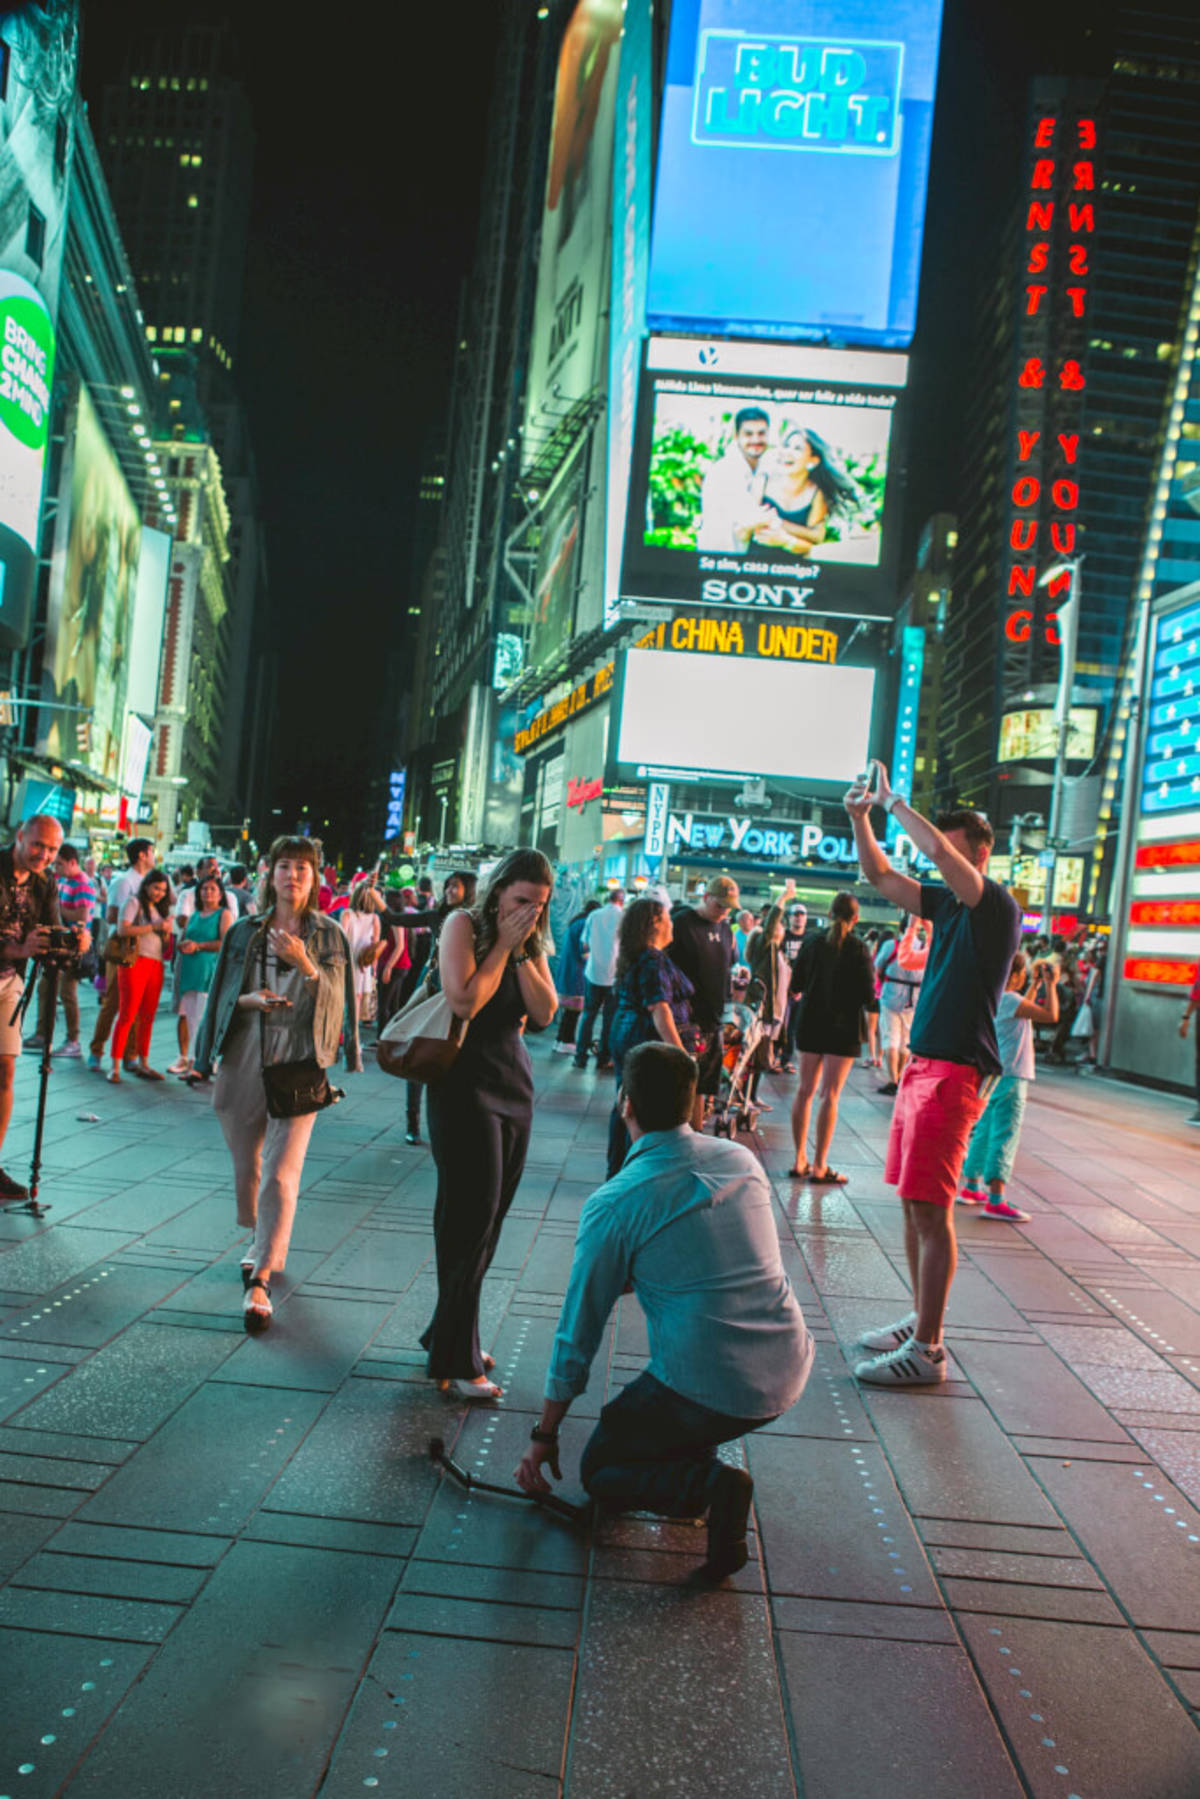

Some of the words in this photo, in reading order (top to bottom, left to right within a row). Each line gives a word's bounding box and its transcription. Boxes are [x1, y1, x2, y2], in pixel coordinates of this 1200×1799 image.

[734, 44, 867, 93] BUD
[1026, 117, 1057, 315] ERNST
[1018, 357, 1046, 389] &
[1005, 430, 1041, 642] YOUNG
[702, 579, 815, 608] SONY
[671, 617, 744, 654] CHINA
[757, 623, 839, 665] UNDER
[651, 784, 666, 854] NYPD
